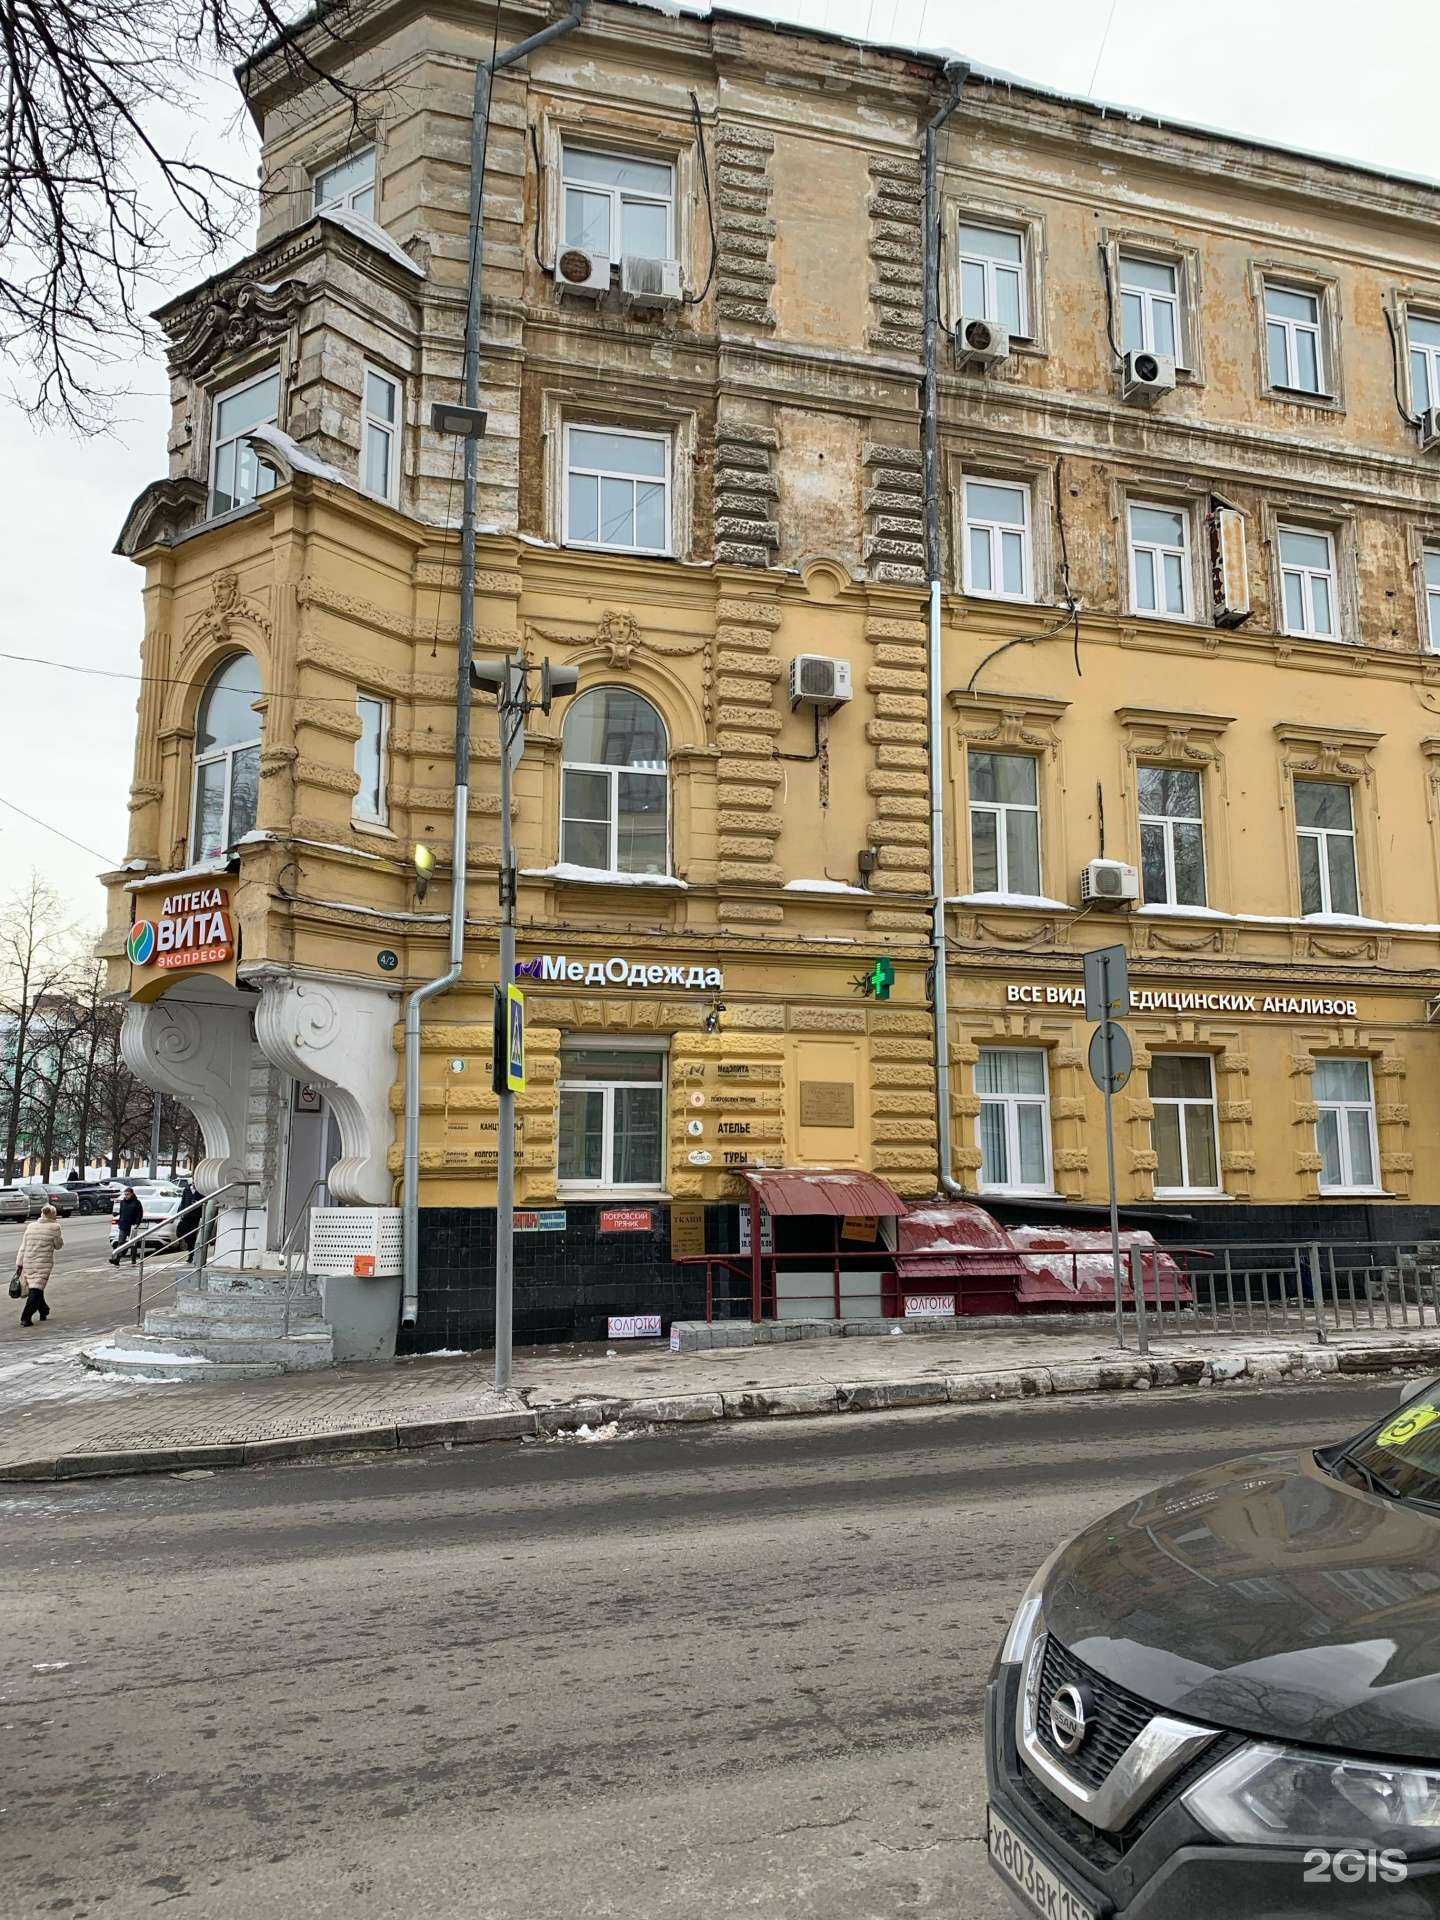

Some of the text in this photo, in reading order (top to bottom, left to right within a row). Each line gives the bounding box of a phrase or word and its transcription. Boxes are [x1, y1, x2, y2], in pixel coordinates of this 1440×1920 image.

[161, 887, 222, 915] АПТЕКА
[156, 910, 228, 952] ВИТА
[158, 948, 227, 967] ЭКСПРЕСС
[380, 955, 395, 966] 4/2
[542, 954, 721, 990] МедОдежда
[1007, 985, 1358, 1016] ВСЕ ВИД ЕДИЦИНСКИХ АНАЛИЗОВ
[717, 1122, 751, 1134] АТЕЛЬЕ
[723, 1151, 748, 1163] ТУРЫ
[603, 1212, 648, 1220] ПОКРОВСКИЙ
[614, 1219, 640, 1228] ПРЯНИК
[904, 1296, 956, 1310] КОЛГОТКИ
[608, 1317, 661, 1331] КОЛГОТКИ
